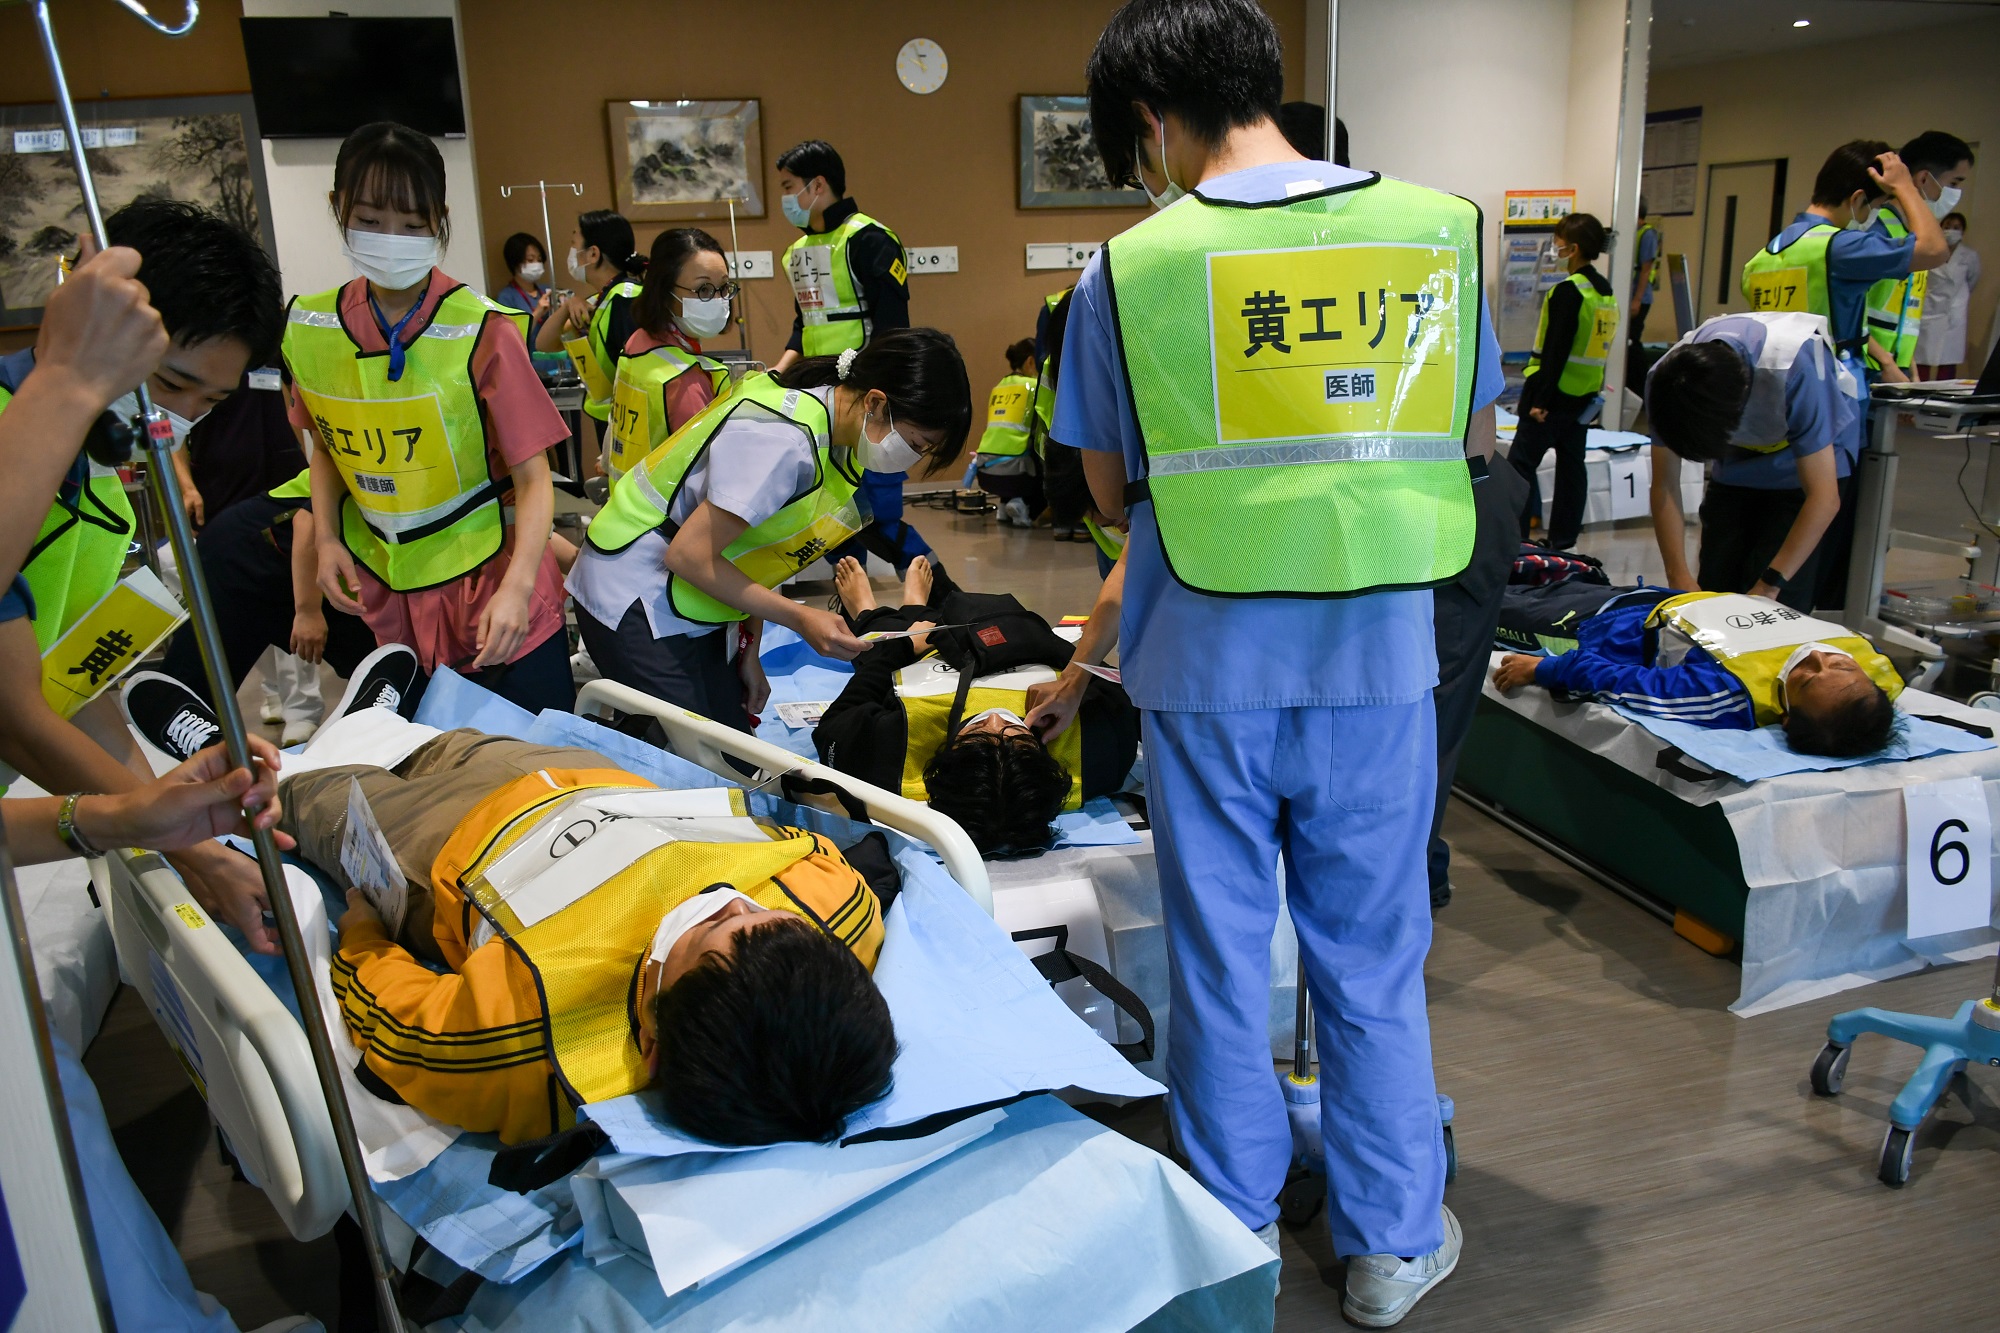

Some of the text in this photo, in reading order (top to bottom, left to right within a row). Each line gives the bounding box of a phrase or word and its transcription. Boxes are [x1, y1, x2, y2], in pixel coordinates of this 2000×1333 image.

[794, 268, 830, 283] ローラー
[1753, 285, 1797, 310] 黄エリア
[1241, 288, 1435, 359] 黄エリア
[1325, 372, 1375, 400] 医師
[314, 414, 423, 465] 黄エリア
[355, 473, 396, 494] 看護師
[1623, 472, 1635, 498] 1
[785, 537, 831, 568] 黄
[67, 629, 140, 686] 黄
[1930, 818, 1970, 886] 6
